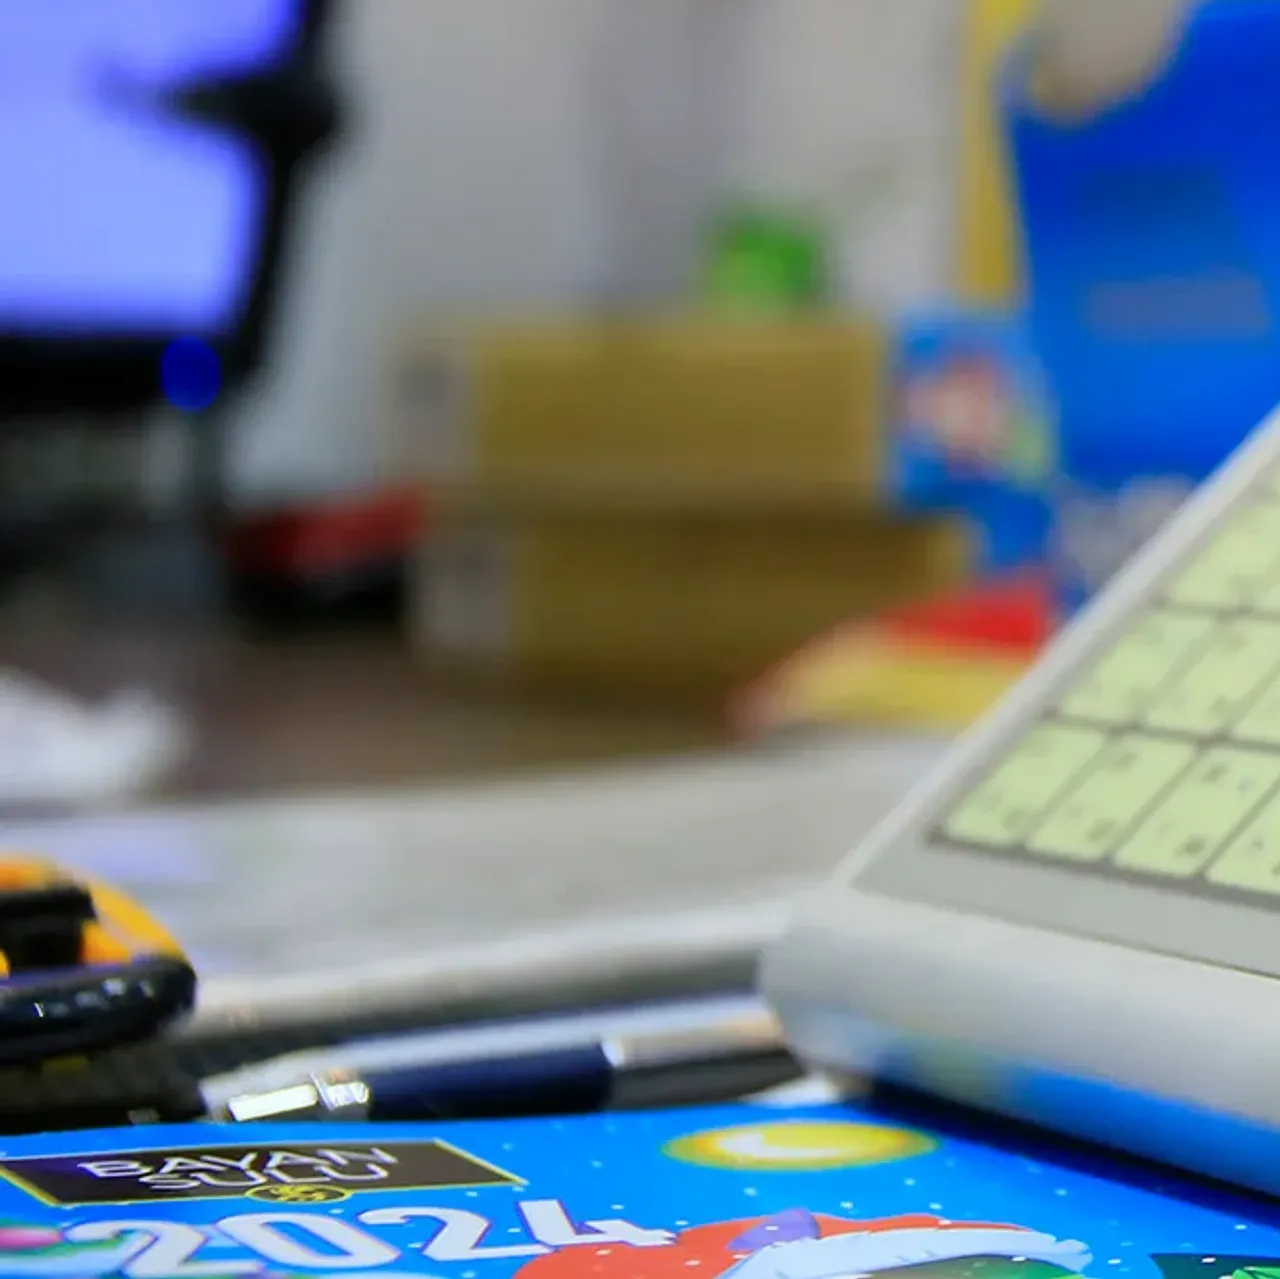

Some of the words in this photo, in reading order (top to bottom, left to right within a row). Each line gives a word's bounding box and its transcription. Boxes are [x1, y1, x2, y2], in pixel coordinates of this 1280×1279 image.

[77, 1147, 399, 1178] BAYAN
[138, 1163, 390, 1189] SULU
[63, 1200, 678, 1278] 2024
